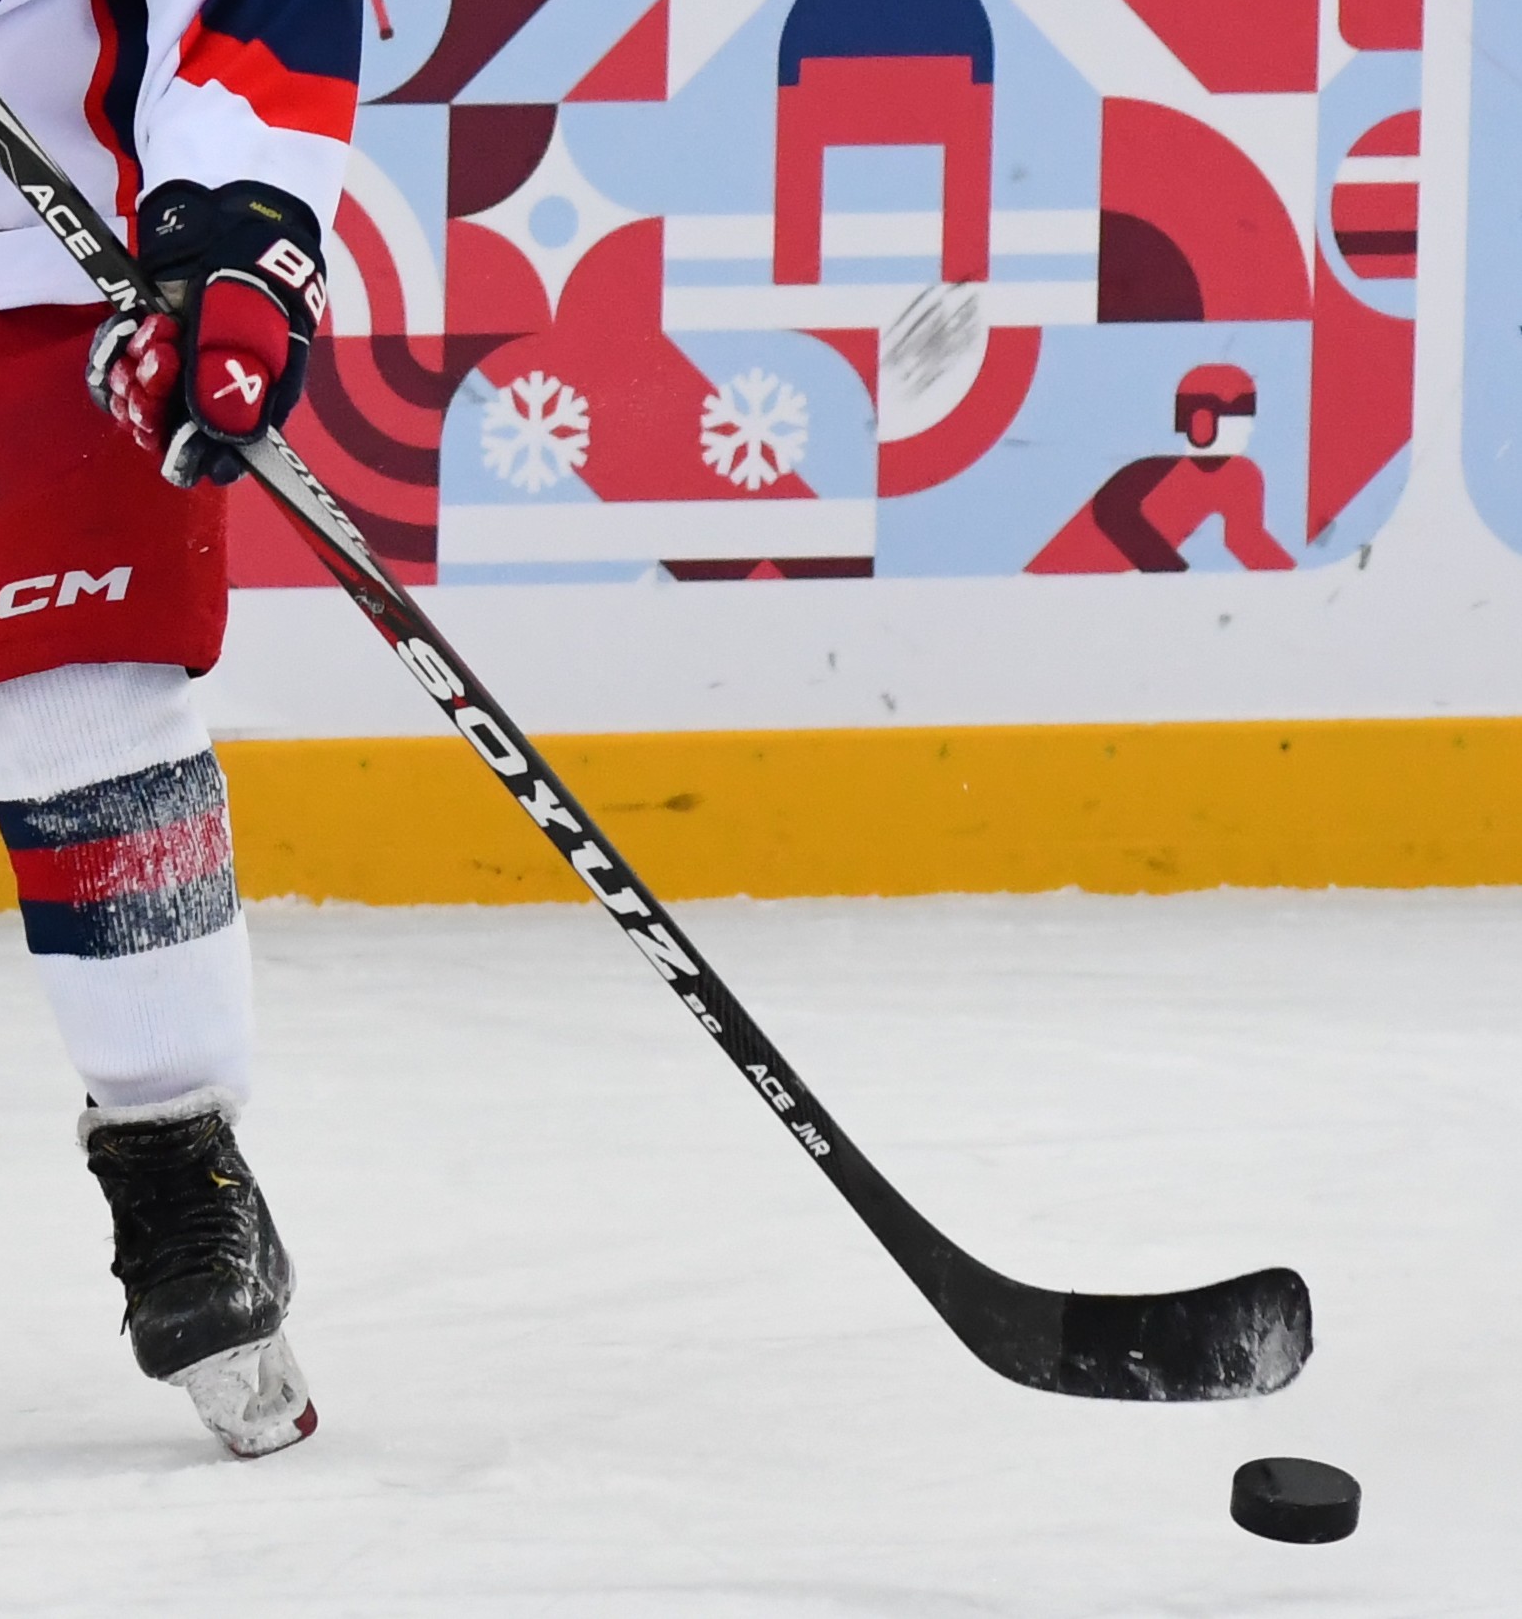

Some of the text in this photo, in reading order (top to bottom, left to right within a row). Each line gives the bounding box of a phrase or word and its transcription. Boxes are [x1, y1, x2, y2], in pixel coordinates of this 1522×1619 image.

[21, 185, 147, 312] ACE JN
[397, 637, 698, 982] SOYUZ
[746, 1064, 831, 1157] ACE JNR
